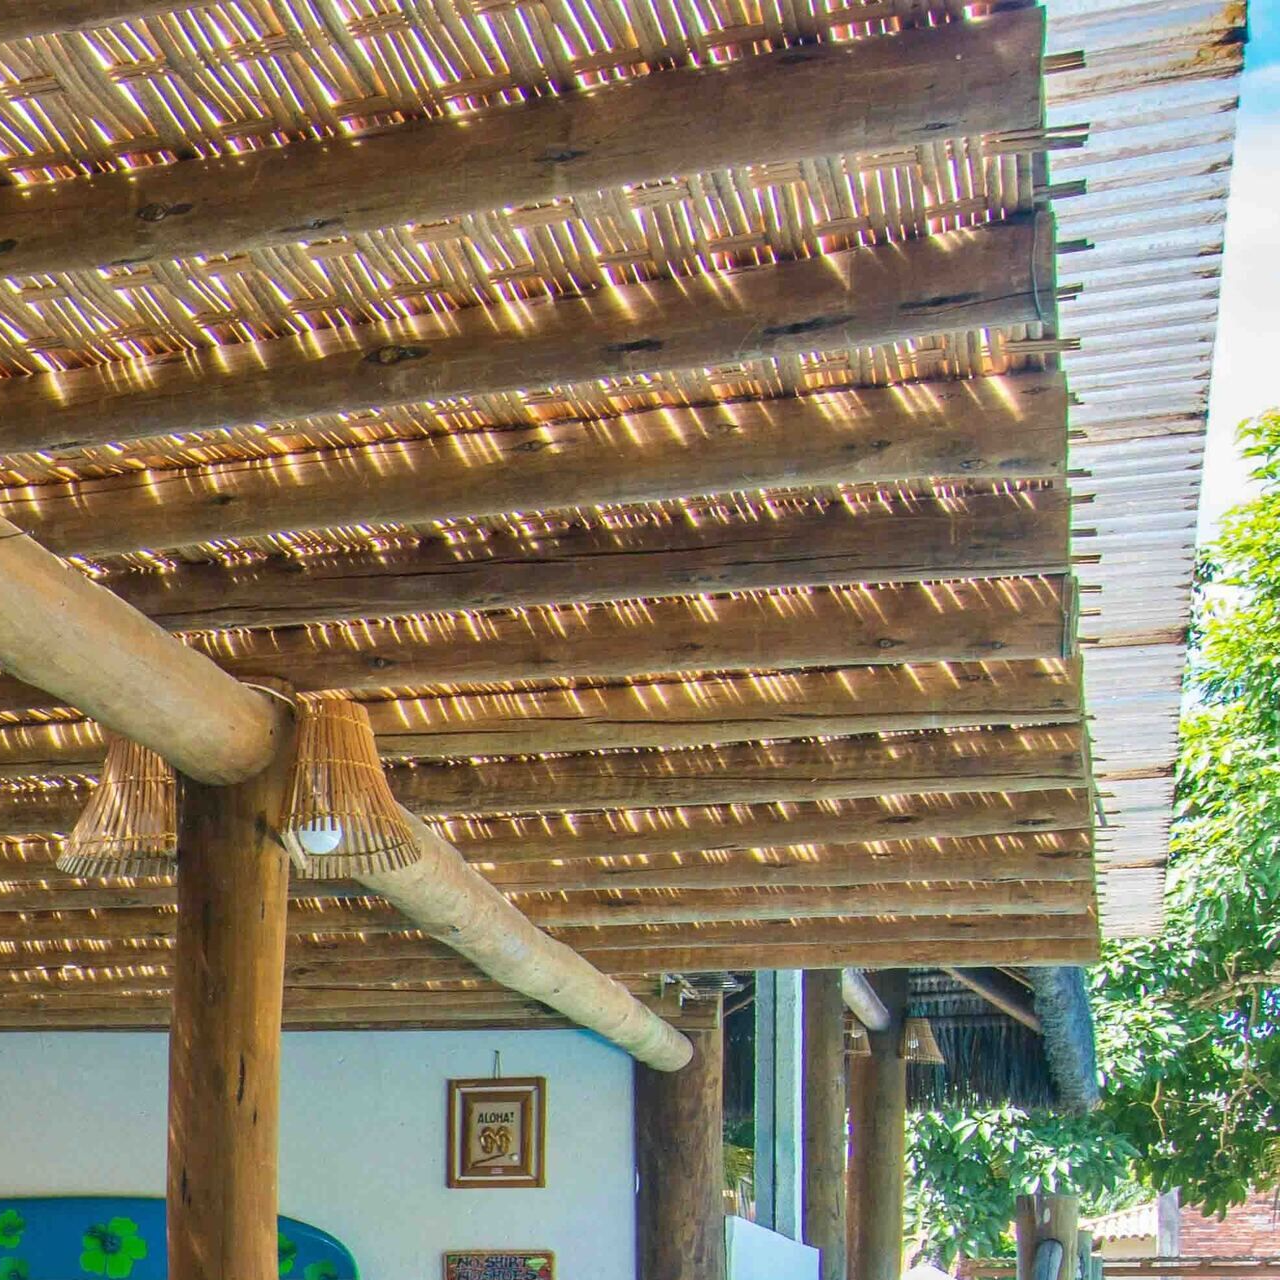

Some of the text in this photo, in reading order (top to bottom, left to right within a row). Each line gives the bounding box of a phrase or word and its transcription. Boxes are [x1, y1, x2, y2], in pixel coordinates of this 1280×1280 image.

[457, 1256, 528, 1268] NO SHIRT
[482, 1269, 537, 1280] SHOES
